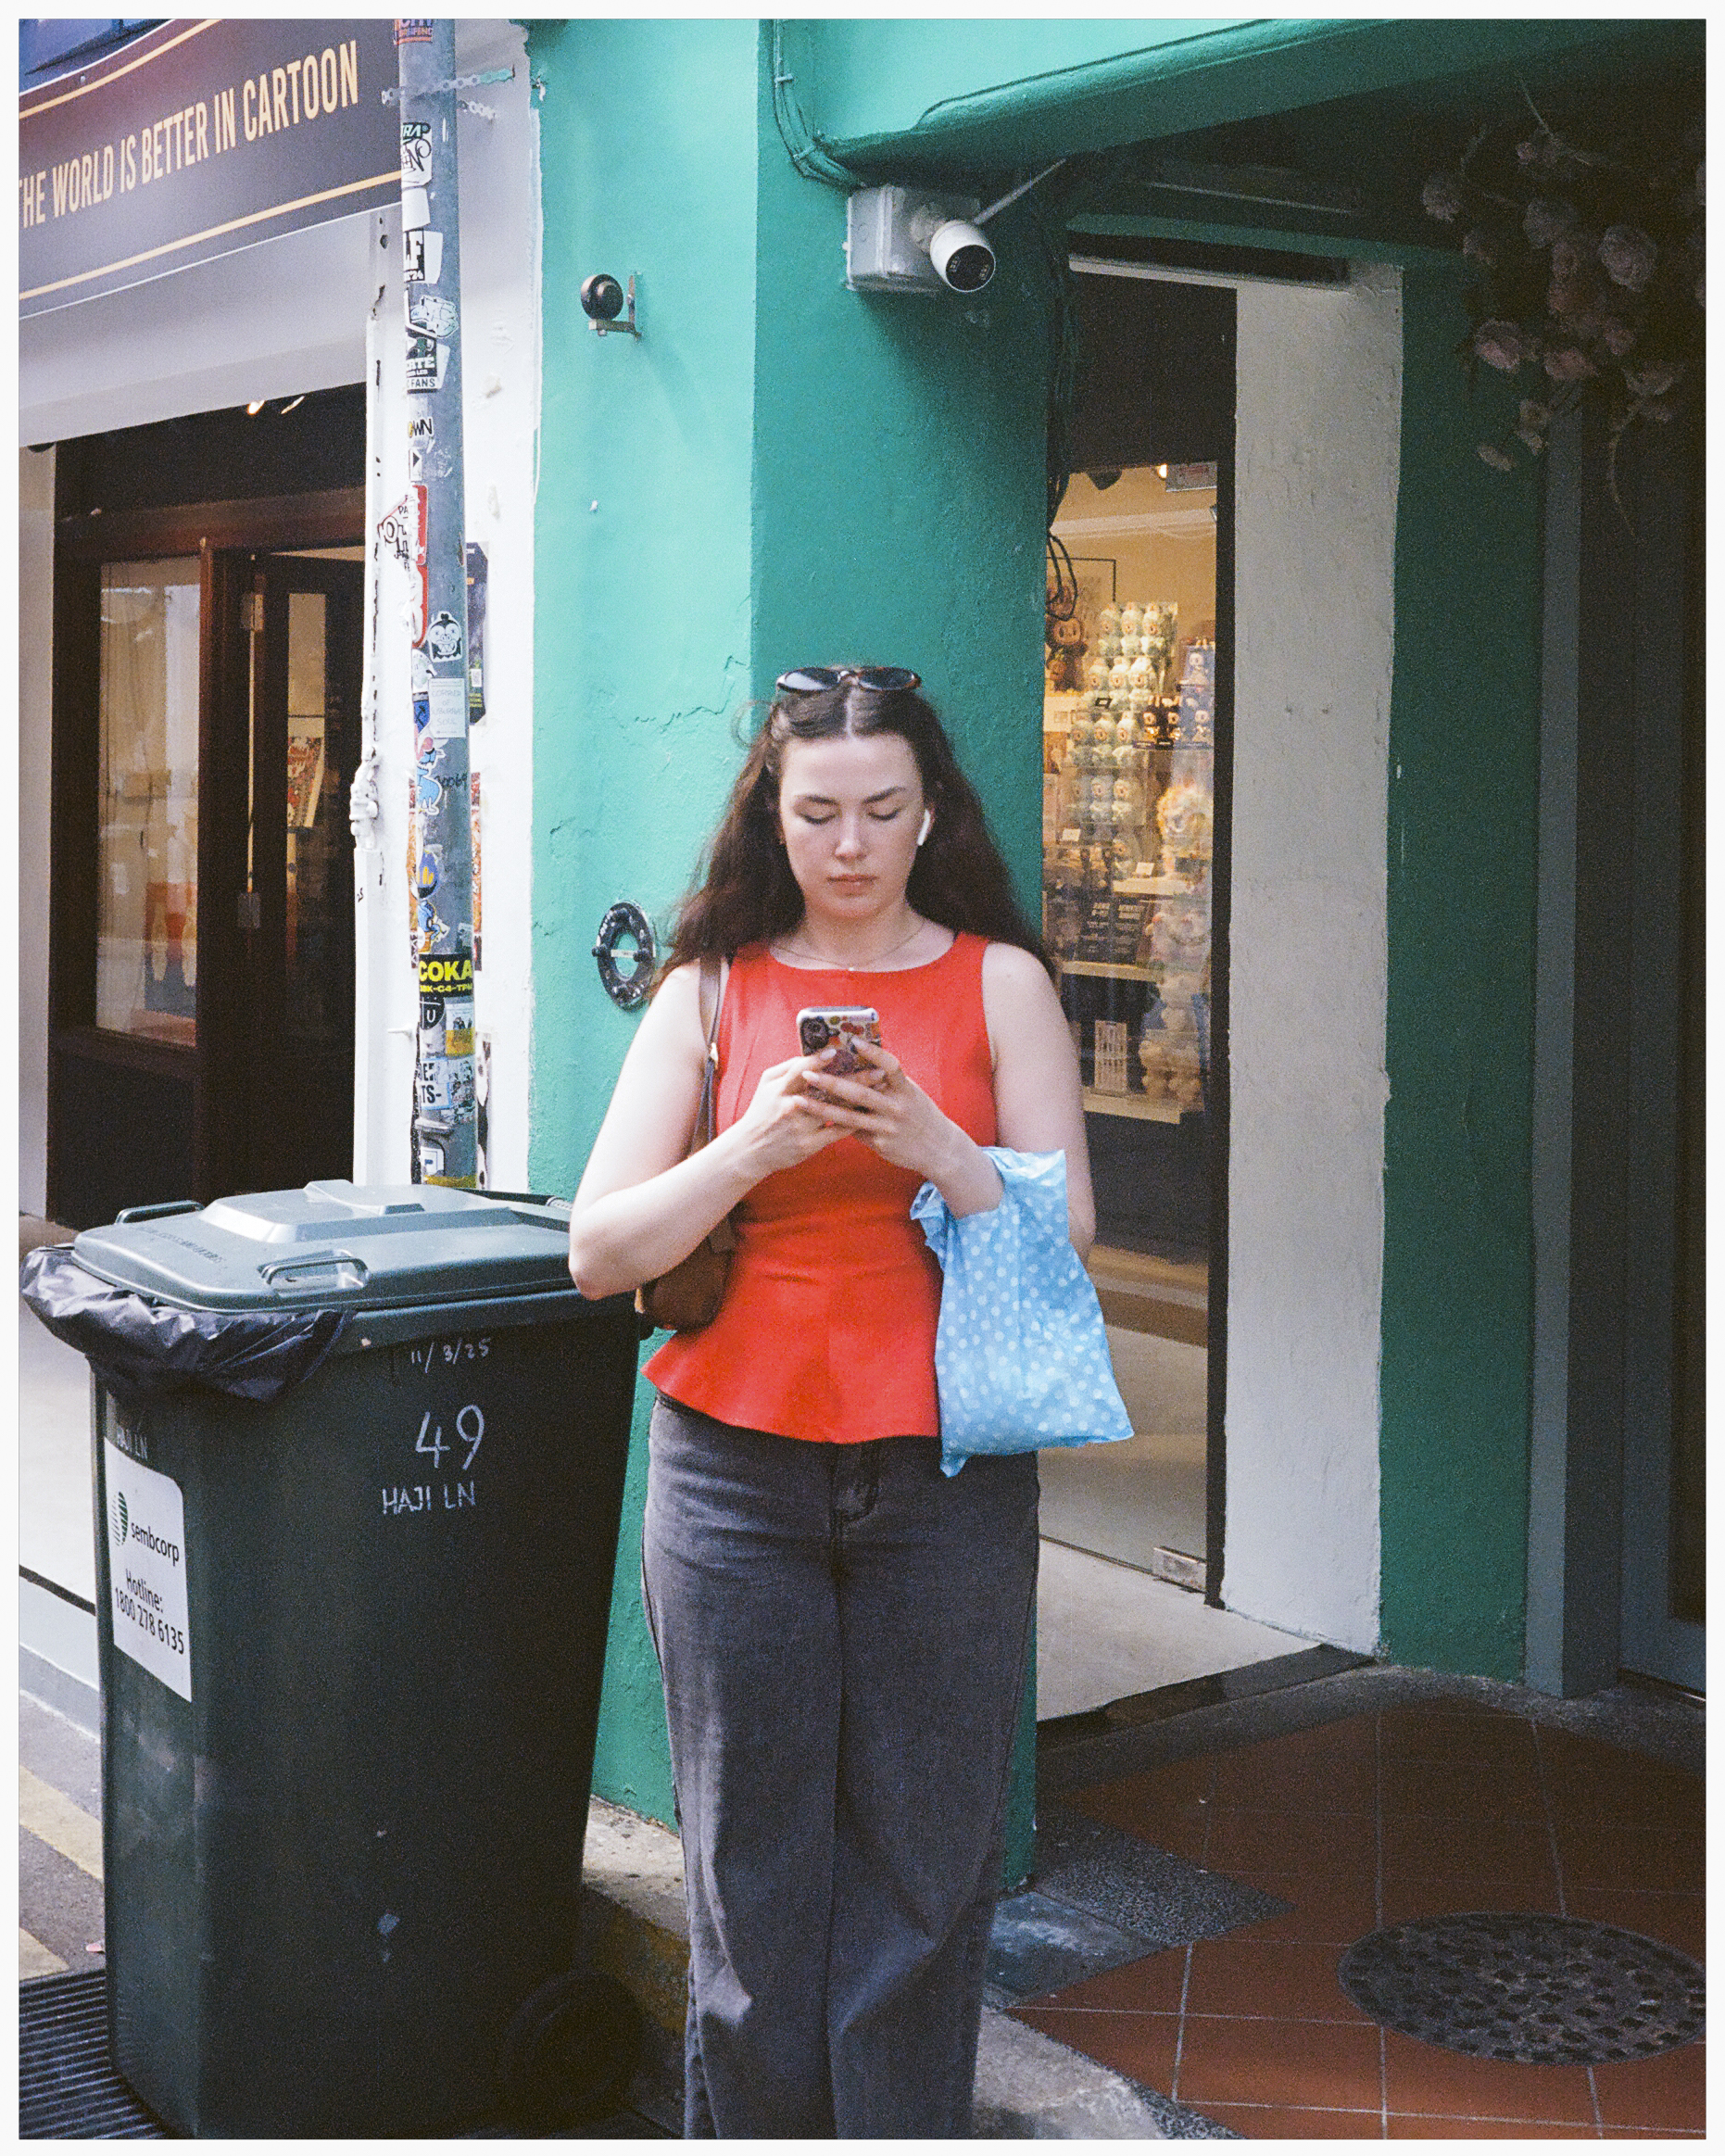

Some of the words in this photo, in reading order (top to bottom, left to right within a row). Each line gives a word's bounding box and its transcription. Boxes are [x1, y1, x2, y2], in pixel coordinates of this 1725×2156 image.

[52, 145, 113, 218] WORLD
[120, 134, 136, 193] IS
[142, 102, 208, 183] BETTER
[214, 88, 236, 154] IN
[243, 40, 359, 141] CARTOON
[410, 377, 435, 388] FANS
[419, 960, 472, 982] COKA
[415, 1405, 485, 1470] 49
[382, 1485, 432, 1515] HAJI
[444, 1481, 476, 1509] LN
[131, 1522, 180, 1566] sembcorp
[126, 1568, 164, 1613] Hotline:
[115, 1587, 136, 1621] 1800
[137, 1604, 156, 1636] 278
[157, 1619, 184, 1655] 6135
